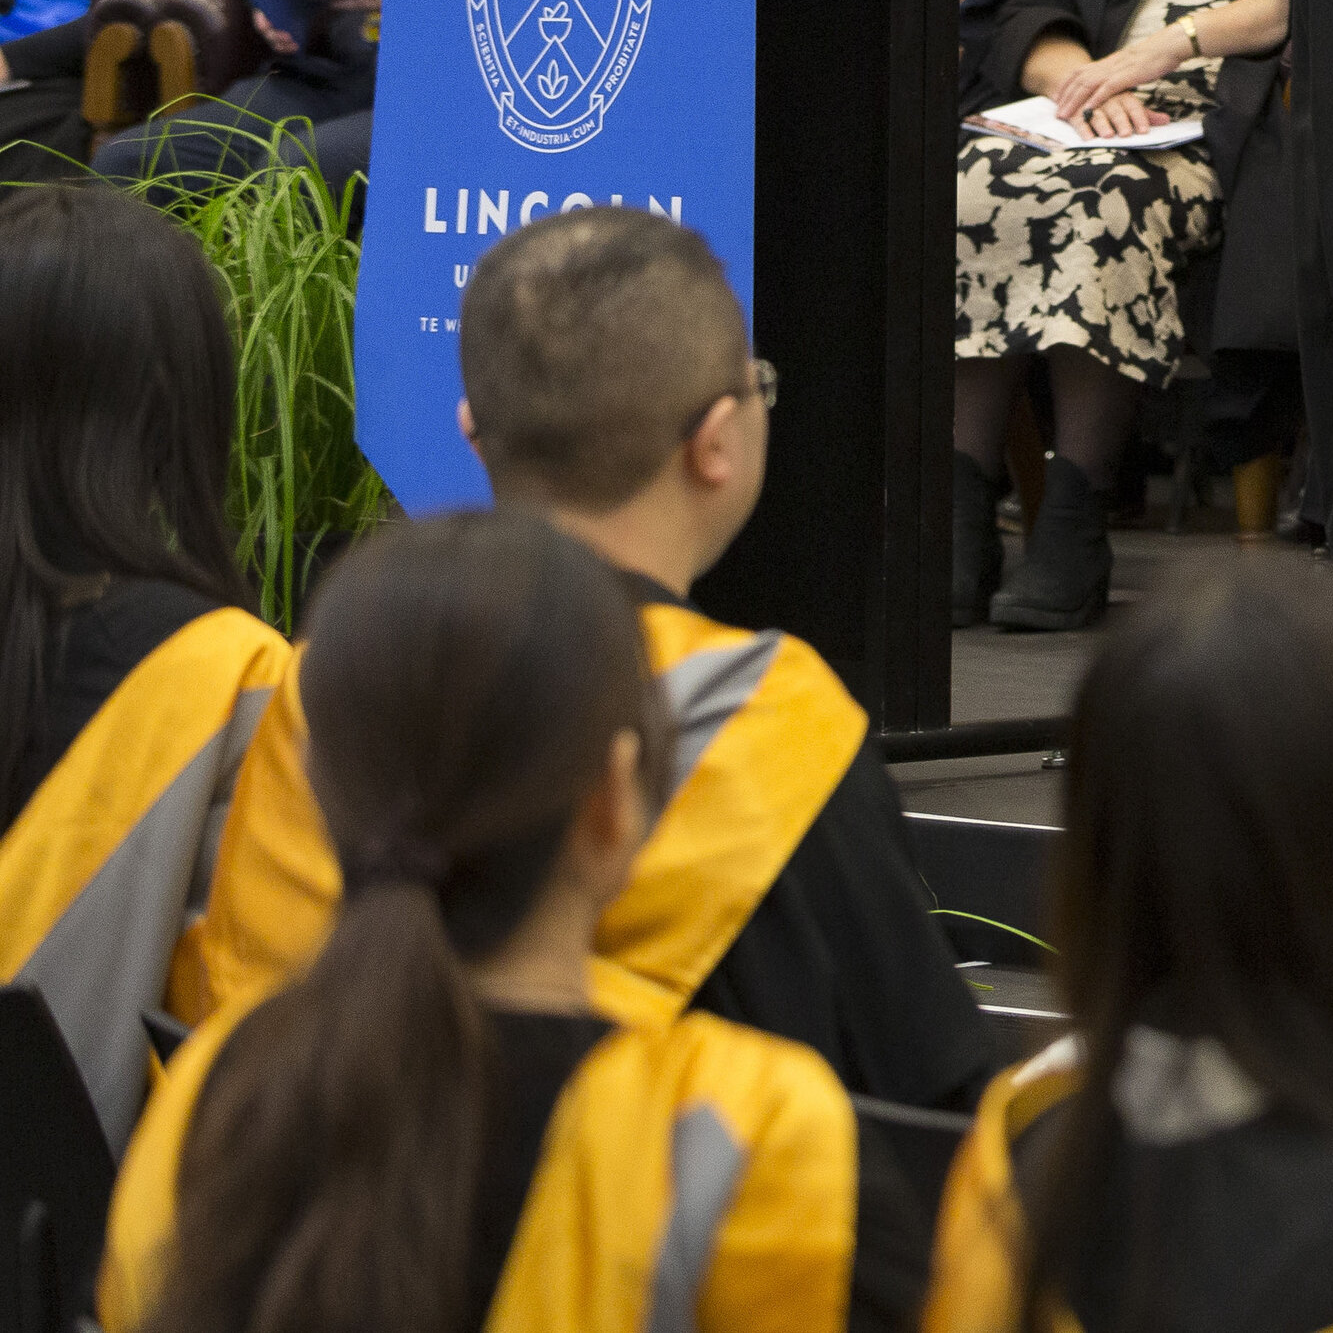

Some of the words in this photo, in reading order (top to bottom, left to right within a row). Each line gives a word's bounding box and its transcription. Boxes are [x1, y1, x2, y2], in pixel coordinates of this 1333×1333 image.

[475, 22, 501, 88] SCIENTIA
[604, 20, 641, 92] PROBITATE
[424, 187, 683, 235] LINCN
[420, 317, 439, 332] TE
